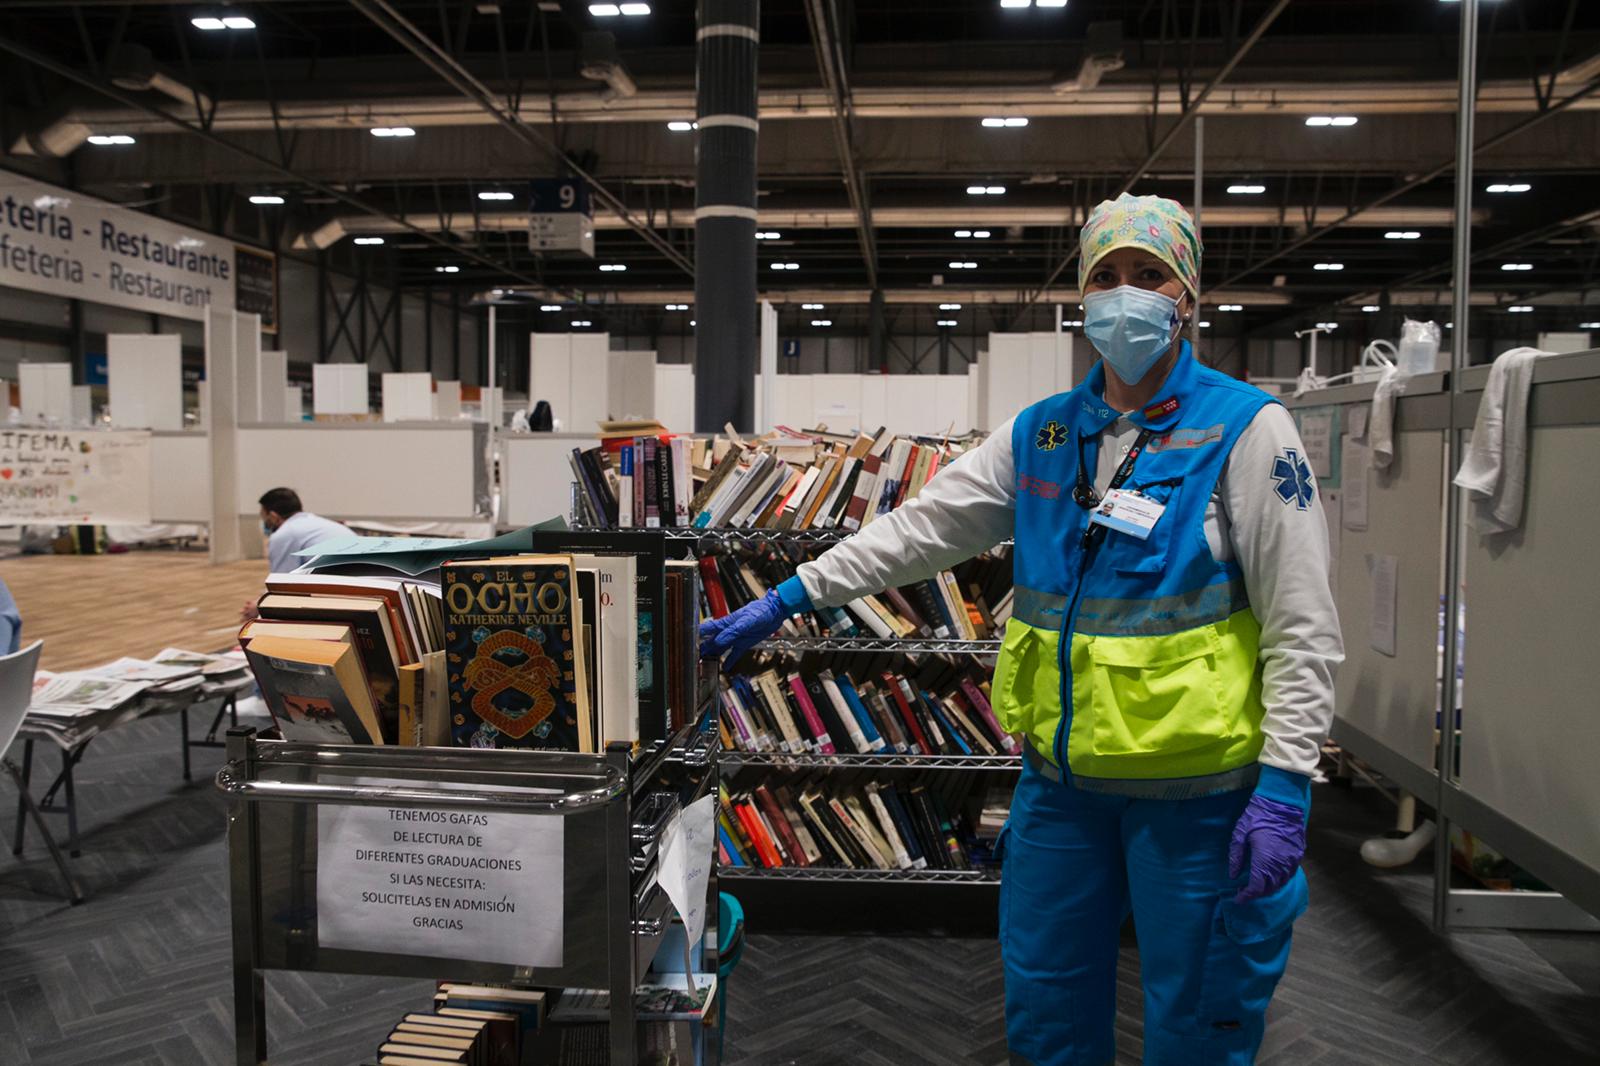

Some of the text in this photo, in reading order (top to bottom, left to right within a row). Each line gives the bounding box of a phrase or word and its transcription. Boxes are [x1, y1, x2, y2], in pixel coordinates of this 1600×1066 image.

[560, 185, 575, 208] 9
[101, 218, 229, 280] Restaurante
[109, 262, 211, 307] Restaurant
[789, 341, 796, 355] J
[1, 432, 74, 452] IFEMA
[496, 571, 513, 581] EL
[446, 582, 567, 614] OCHO
[449, 614, 567, 625] KATHERINE NEVILLE
[389, 809, 488, 826] TENEMOS GAFAS
[393, 831, 483, 847] DE LECTURA DE
[355, 849, 522, 871] DIFERENTES GRADUACIONES
[390, 873, 486, 890] SI LAS NECESITA:
[362, 892, 515, 913] SOLICITELAS EN ADMISIÓN
[413, 916, 464, 930] GRACIAS
